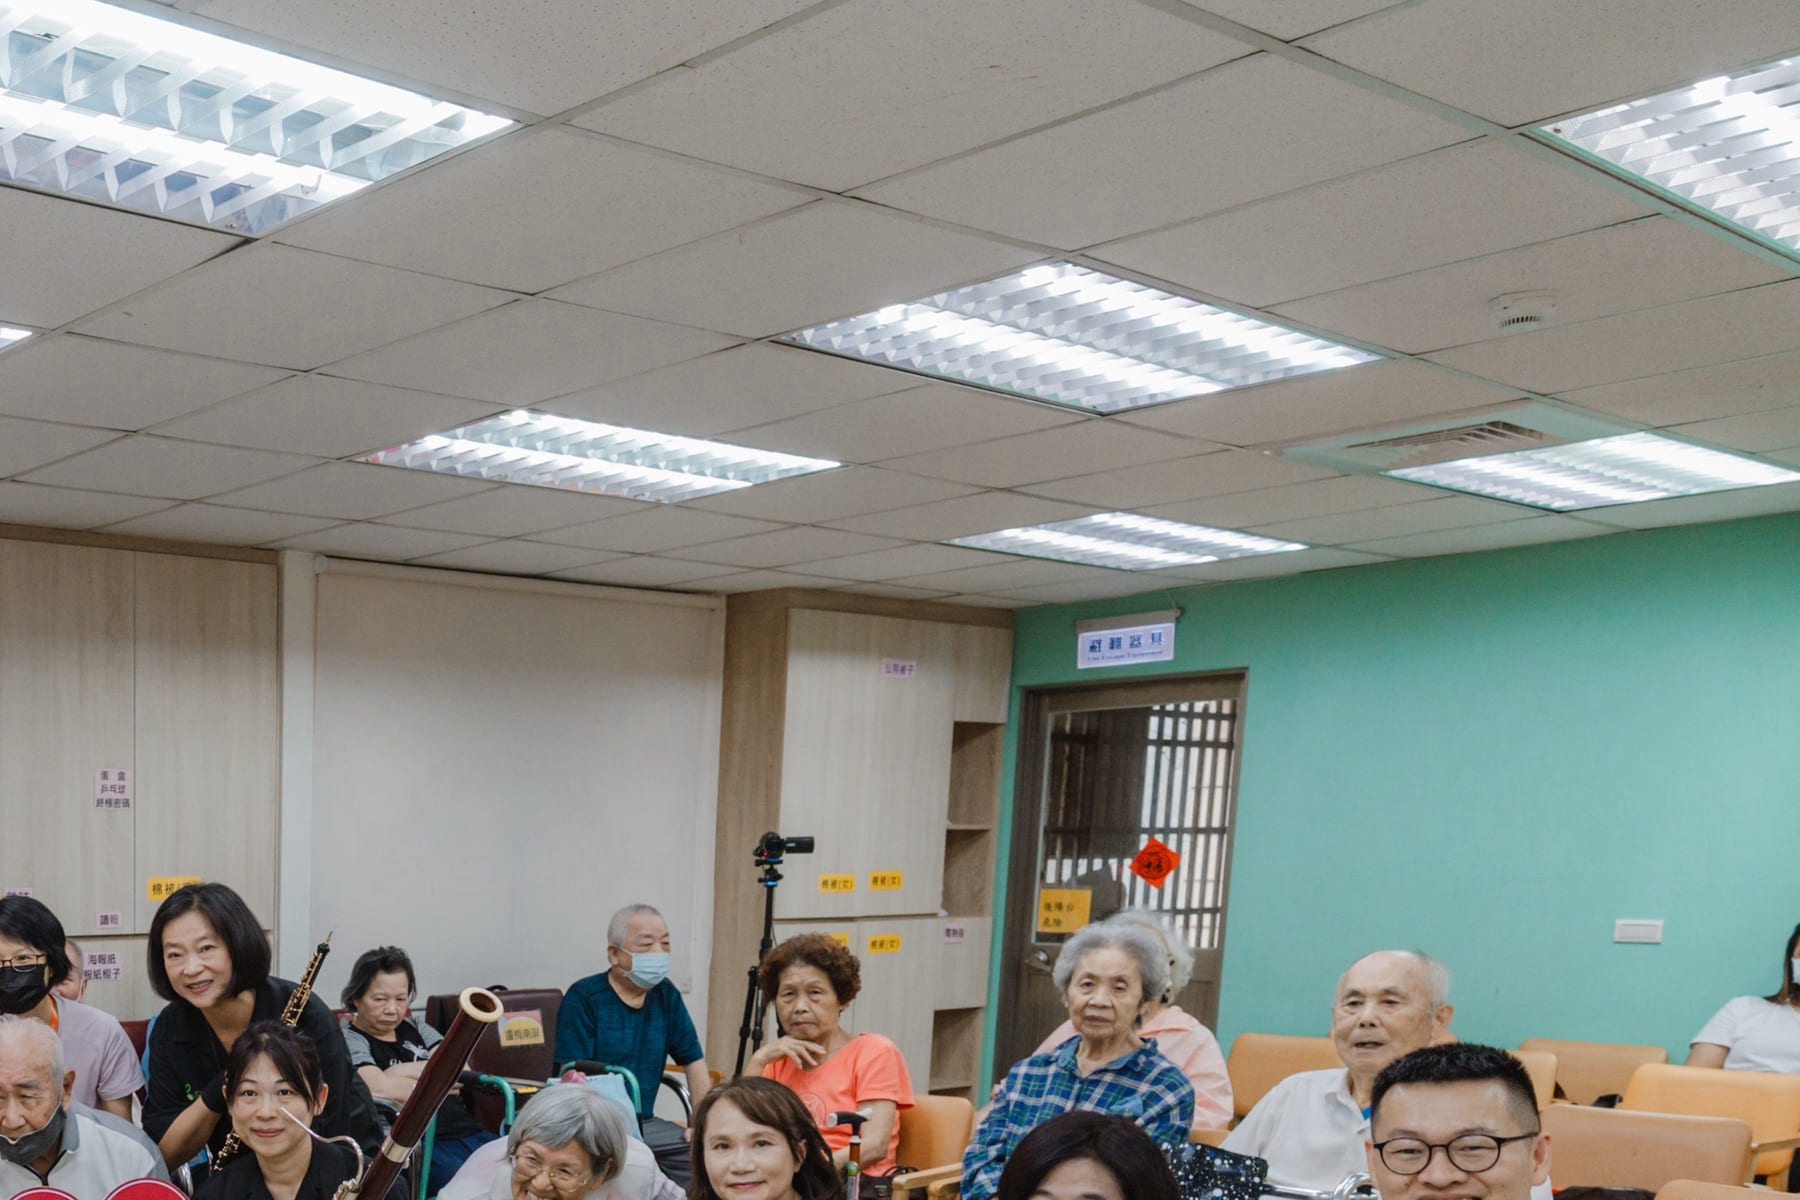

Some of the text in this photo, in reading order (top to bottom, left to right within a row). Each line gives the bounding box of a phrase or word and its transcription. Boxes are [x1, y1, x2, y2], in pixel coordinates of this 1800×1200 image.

[1089, 631, 1162, 653] 避難器具
[101, 784, 126, 794] 乒乓球
[88, 954, 117, 966] 海報紙
